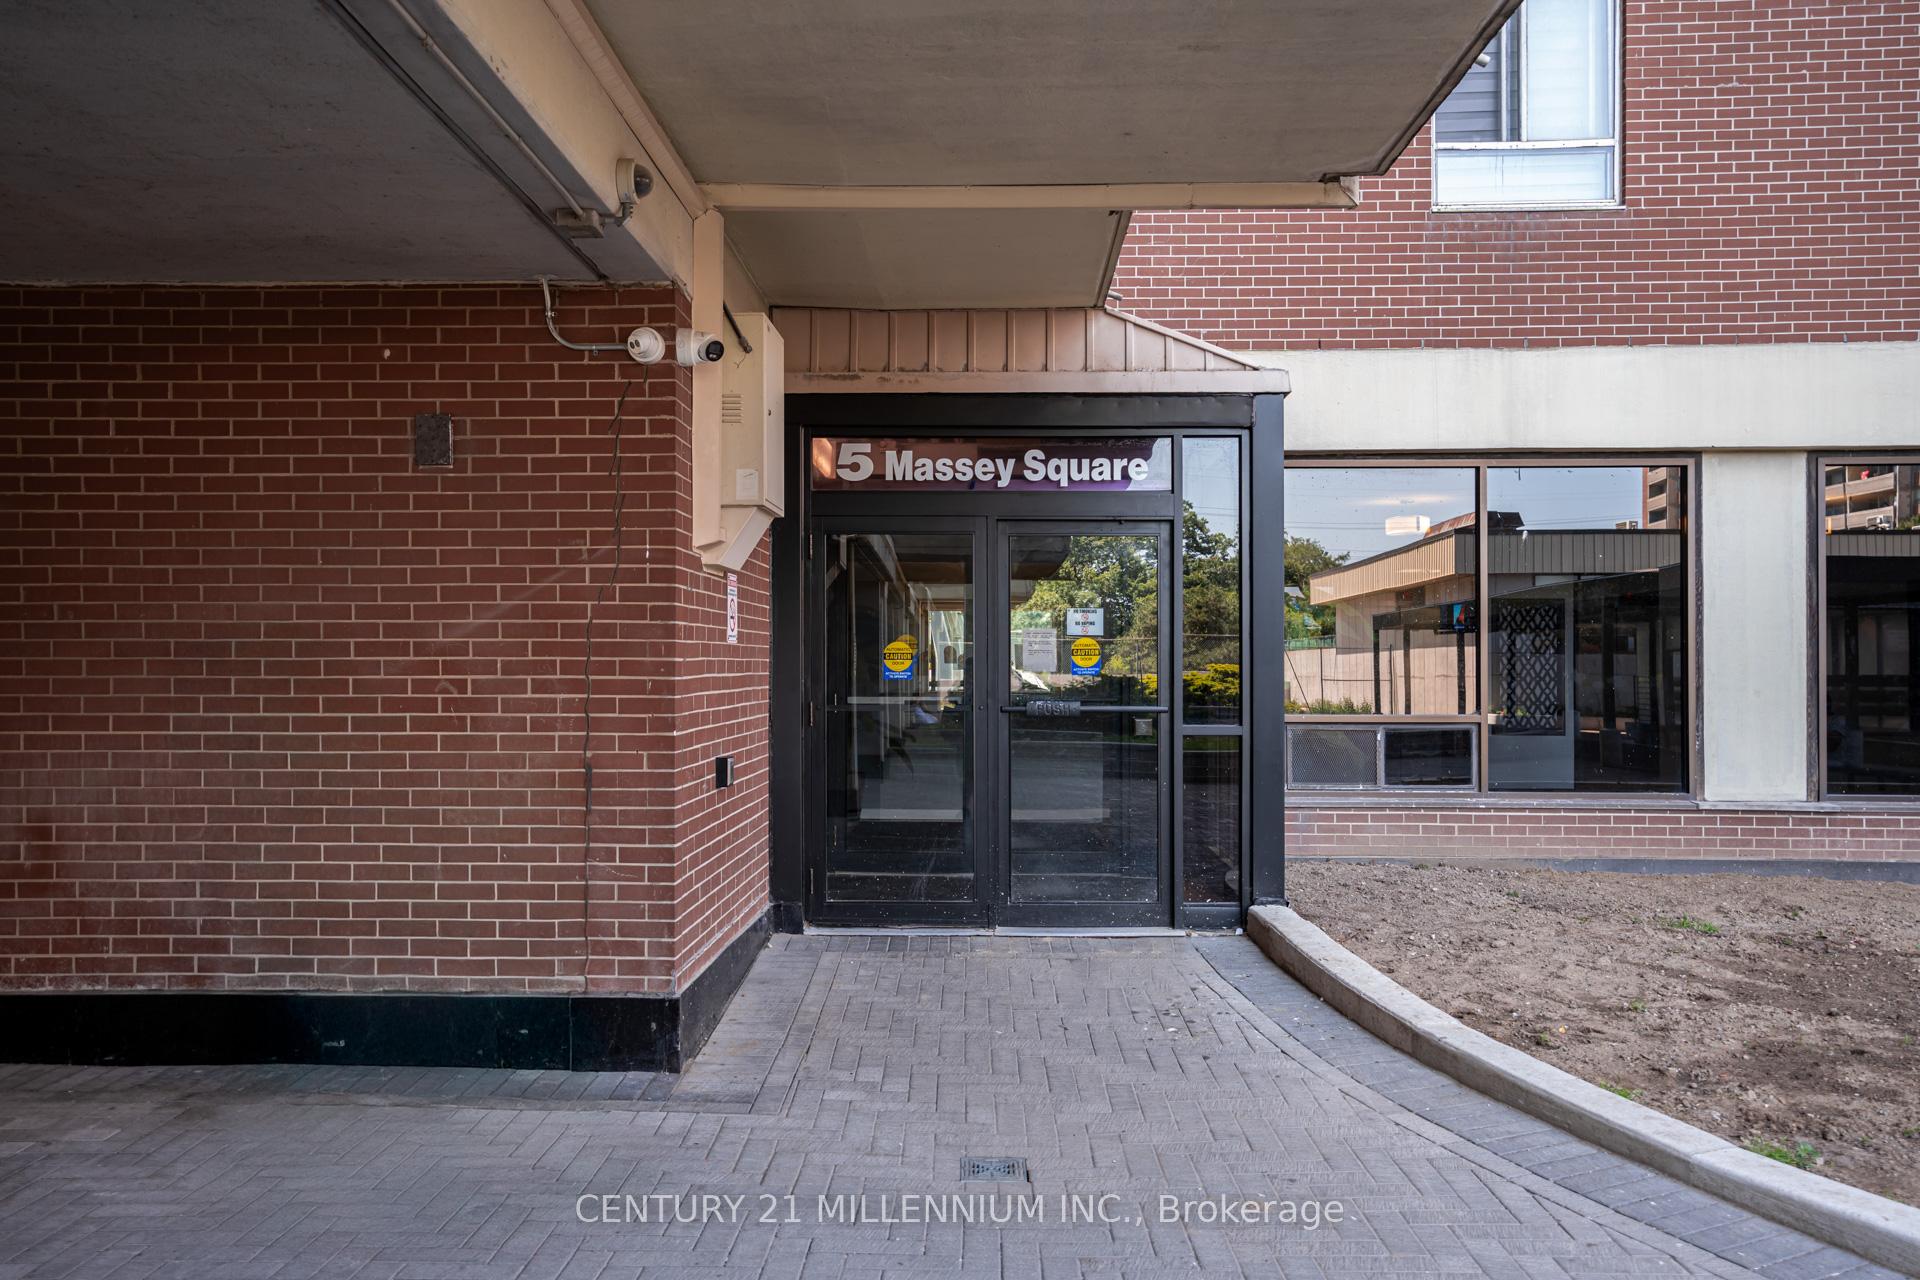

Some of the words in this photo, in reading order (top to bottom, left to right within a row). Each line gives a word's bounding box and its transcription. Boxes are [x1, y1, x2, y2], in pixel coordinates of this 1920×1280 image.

[835, 442, 874, 482] 5
[885, 449, 1016, 488] Massey
[1023, 449, 1149, 487] Square
[1036, 702, 1071, 716] PUSH
